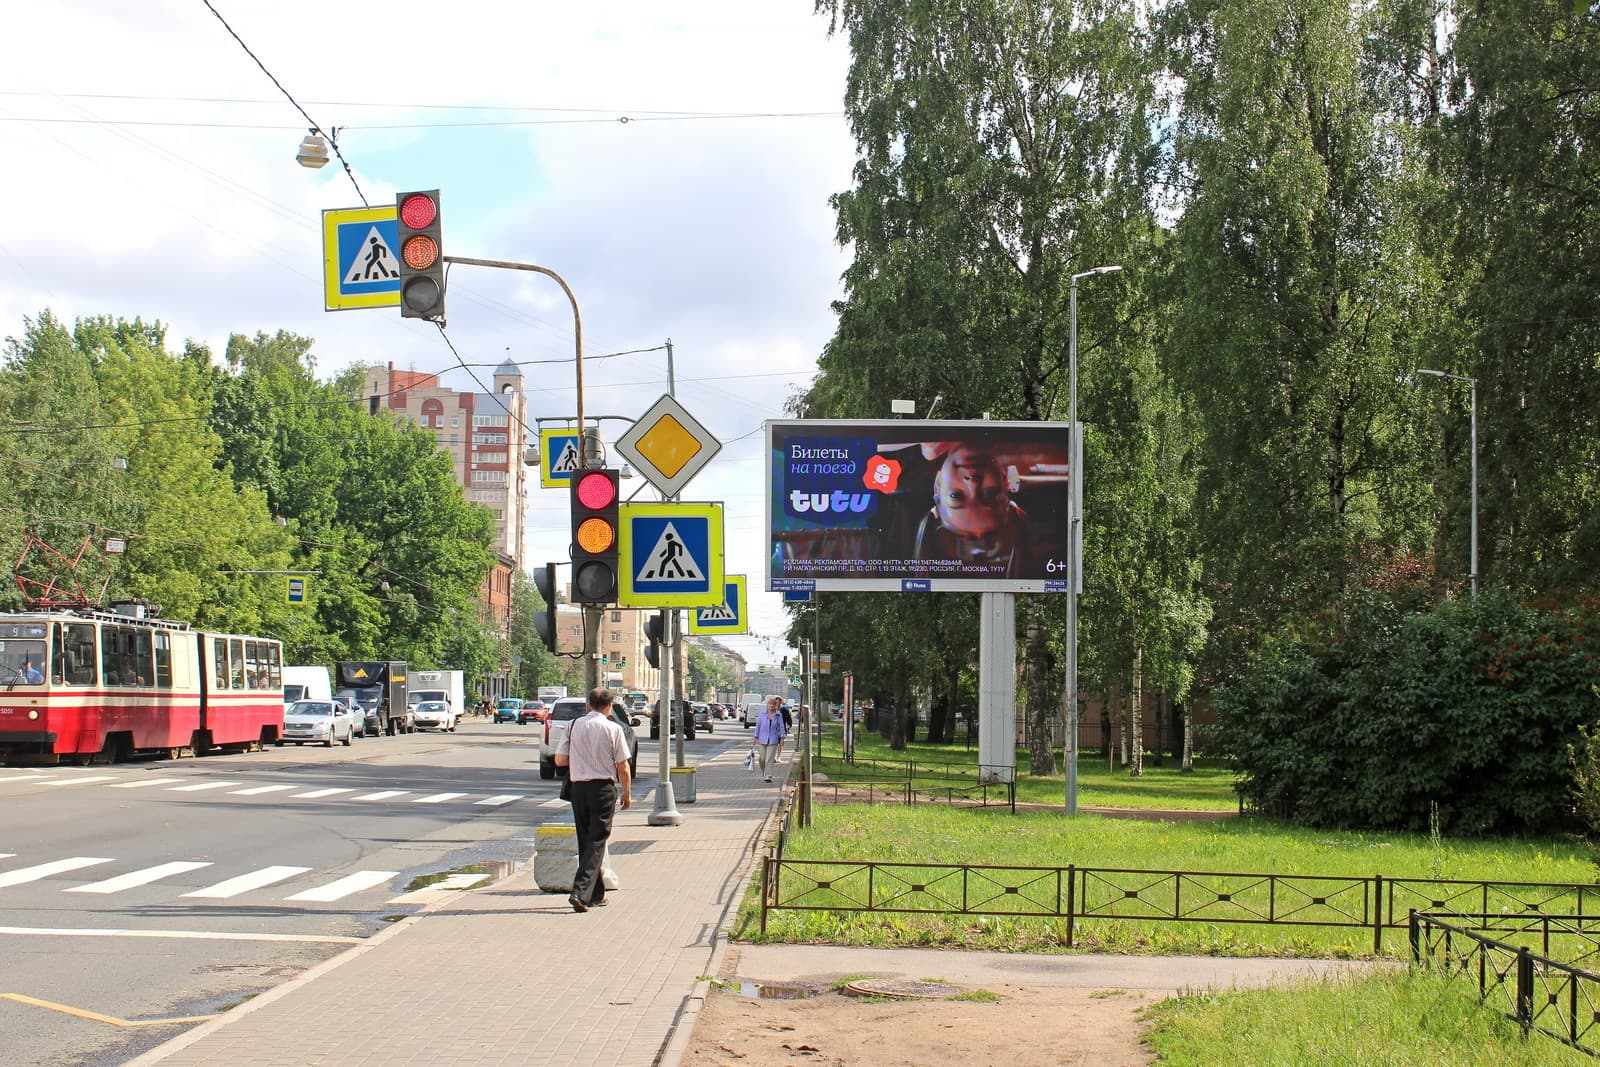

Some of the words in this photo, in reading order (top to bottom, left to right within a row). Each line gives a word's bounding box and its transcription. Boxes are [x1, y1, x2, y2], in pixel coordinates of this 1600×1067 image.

[791, 445, 849, 459] Билеты
[791, 463, 809, 474] на
[813, 460, 857, 474] поезд
[790, 490, 871, 513] tutu
[1046, 558, 1067, 573] 6+
